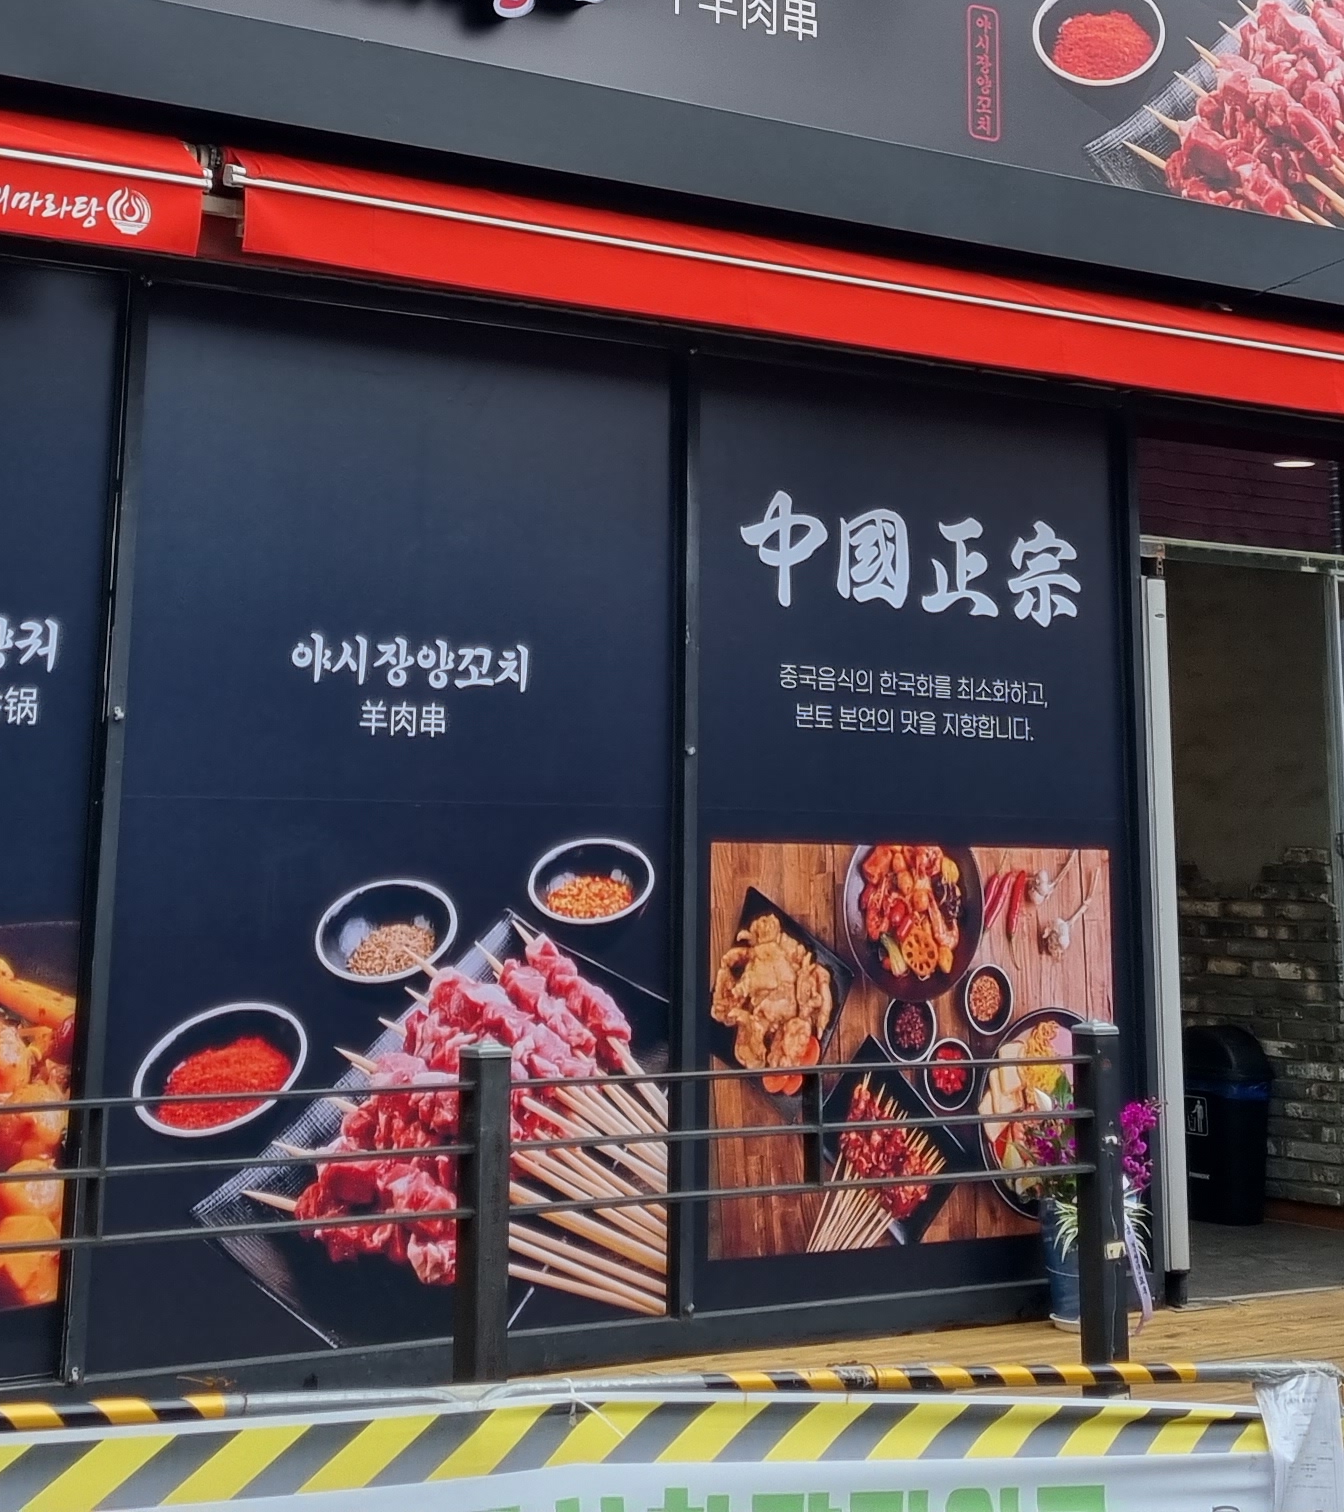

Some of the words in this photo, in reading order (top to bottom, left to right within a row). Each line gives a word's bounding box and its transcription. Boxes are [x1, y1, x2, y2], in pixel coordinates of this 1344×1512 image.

[739, 489, 1082, 629] 中國正宗
[291, 632, 530, 694] 야시장양꼬치
[778, 662, 874, 697] 중국음식의
[879, 670, 952, 702] 한국화를
[956, 678, 1049, 710] 최소화하고,
[359, 699, 447, 738] 羊肉串
[794, 702, 834, 731] 본토
[839, 705, 895, 735] 본연의
[900, 710, 937, 736] 맛을
[942, 711, 1035, 742] 지향합니다.
